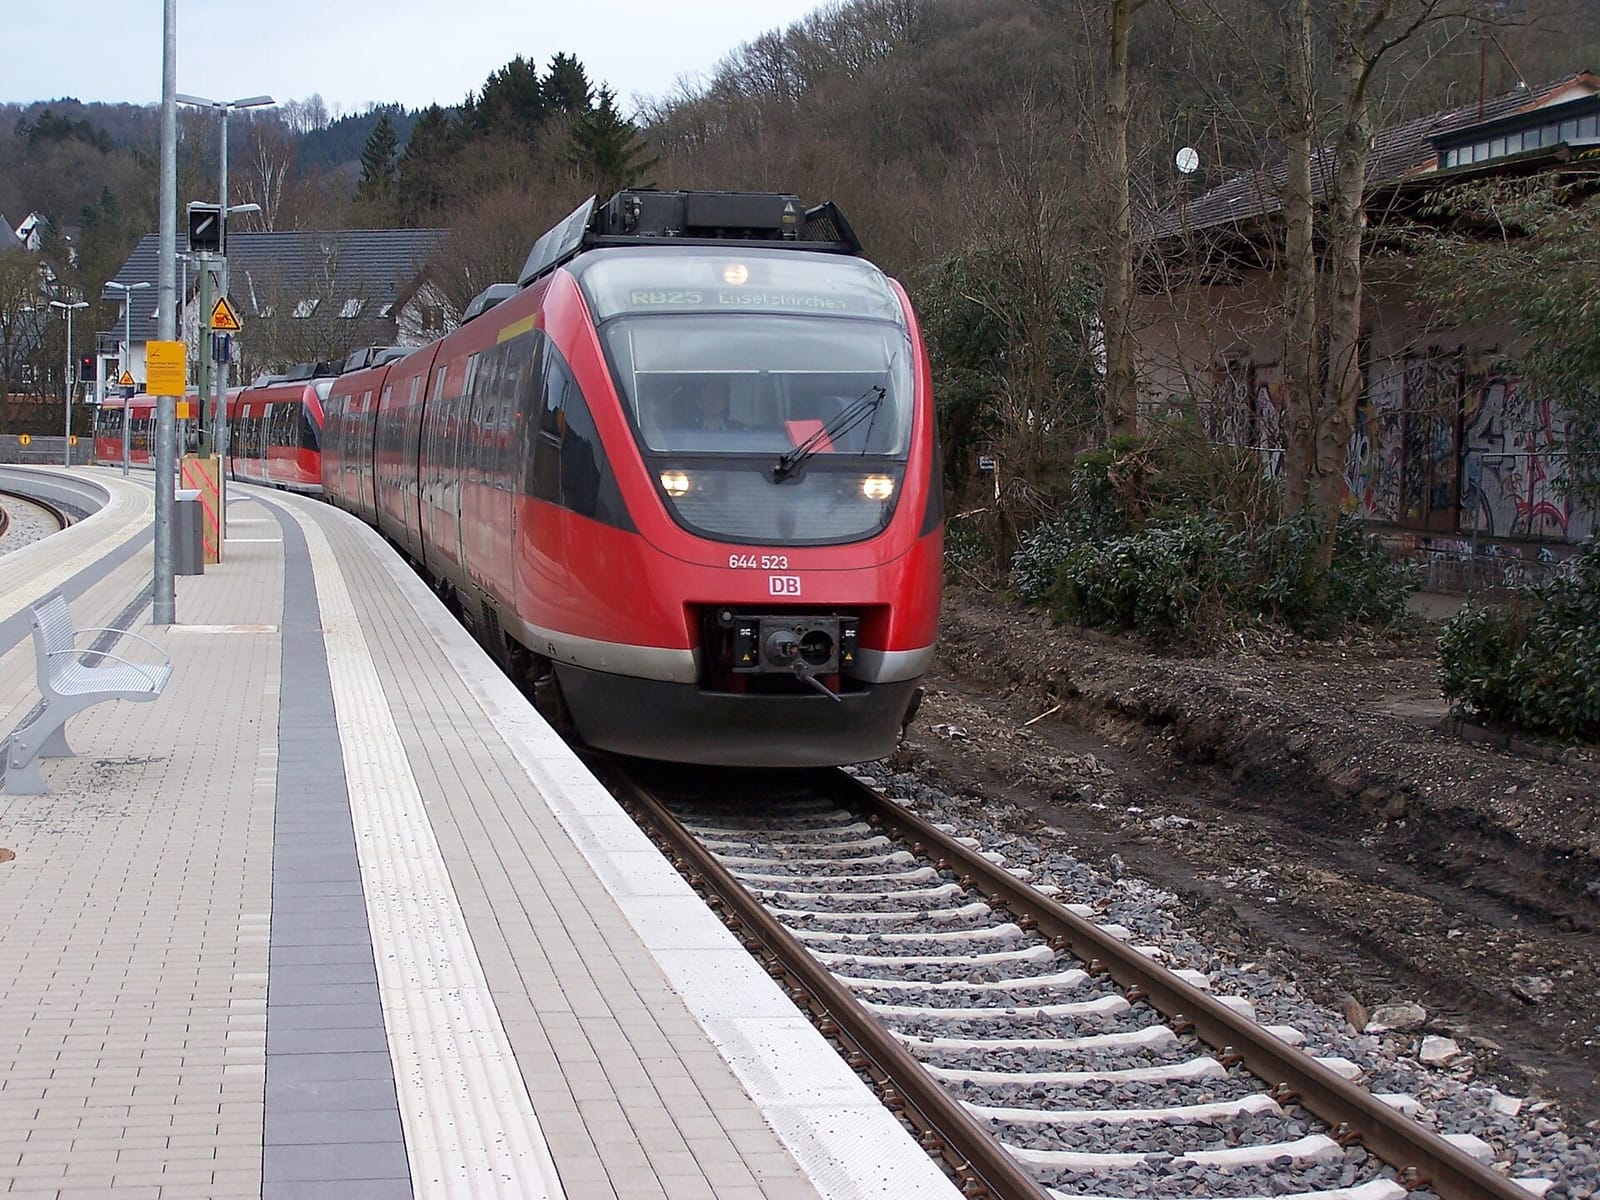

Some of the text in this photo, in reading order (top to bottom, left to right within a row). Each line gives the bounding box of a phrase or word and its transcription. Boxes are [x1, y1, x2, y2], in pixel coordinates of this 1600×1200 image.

[729, 554, 788, 570] 644 523
[770, 576, 799, 594] DB
